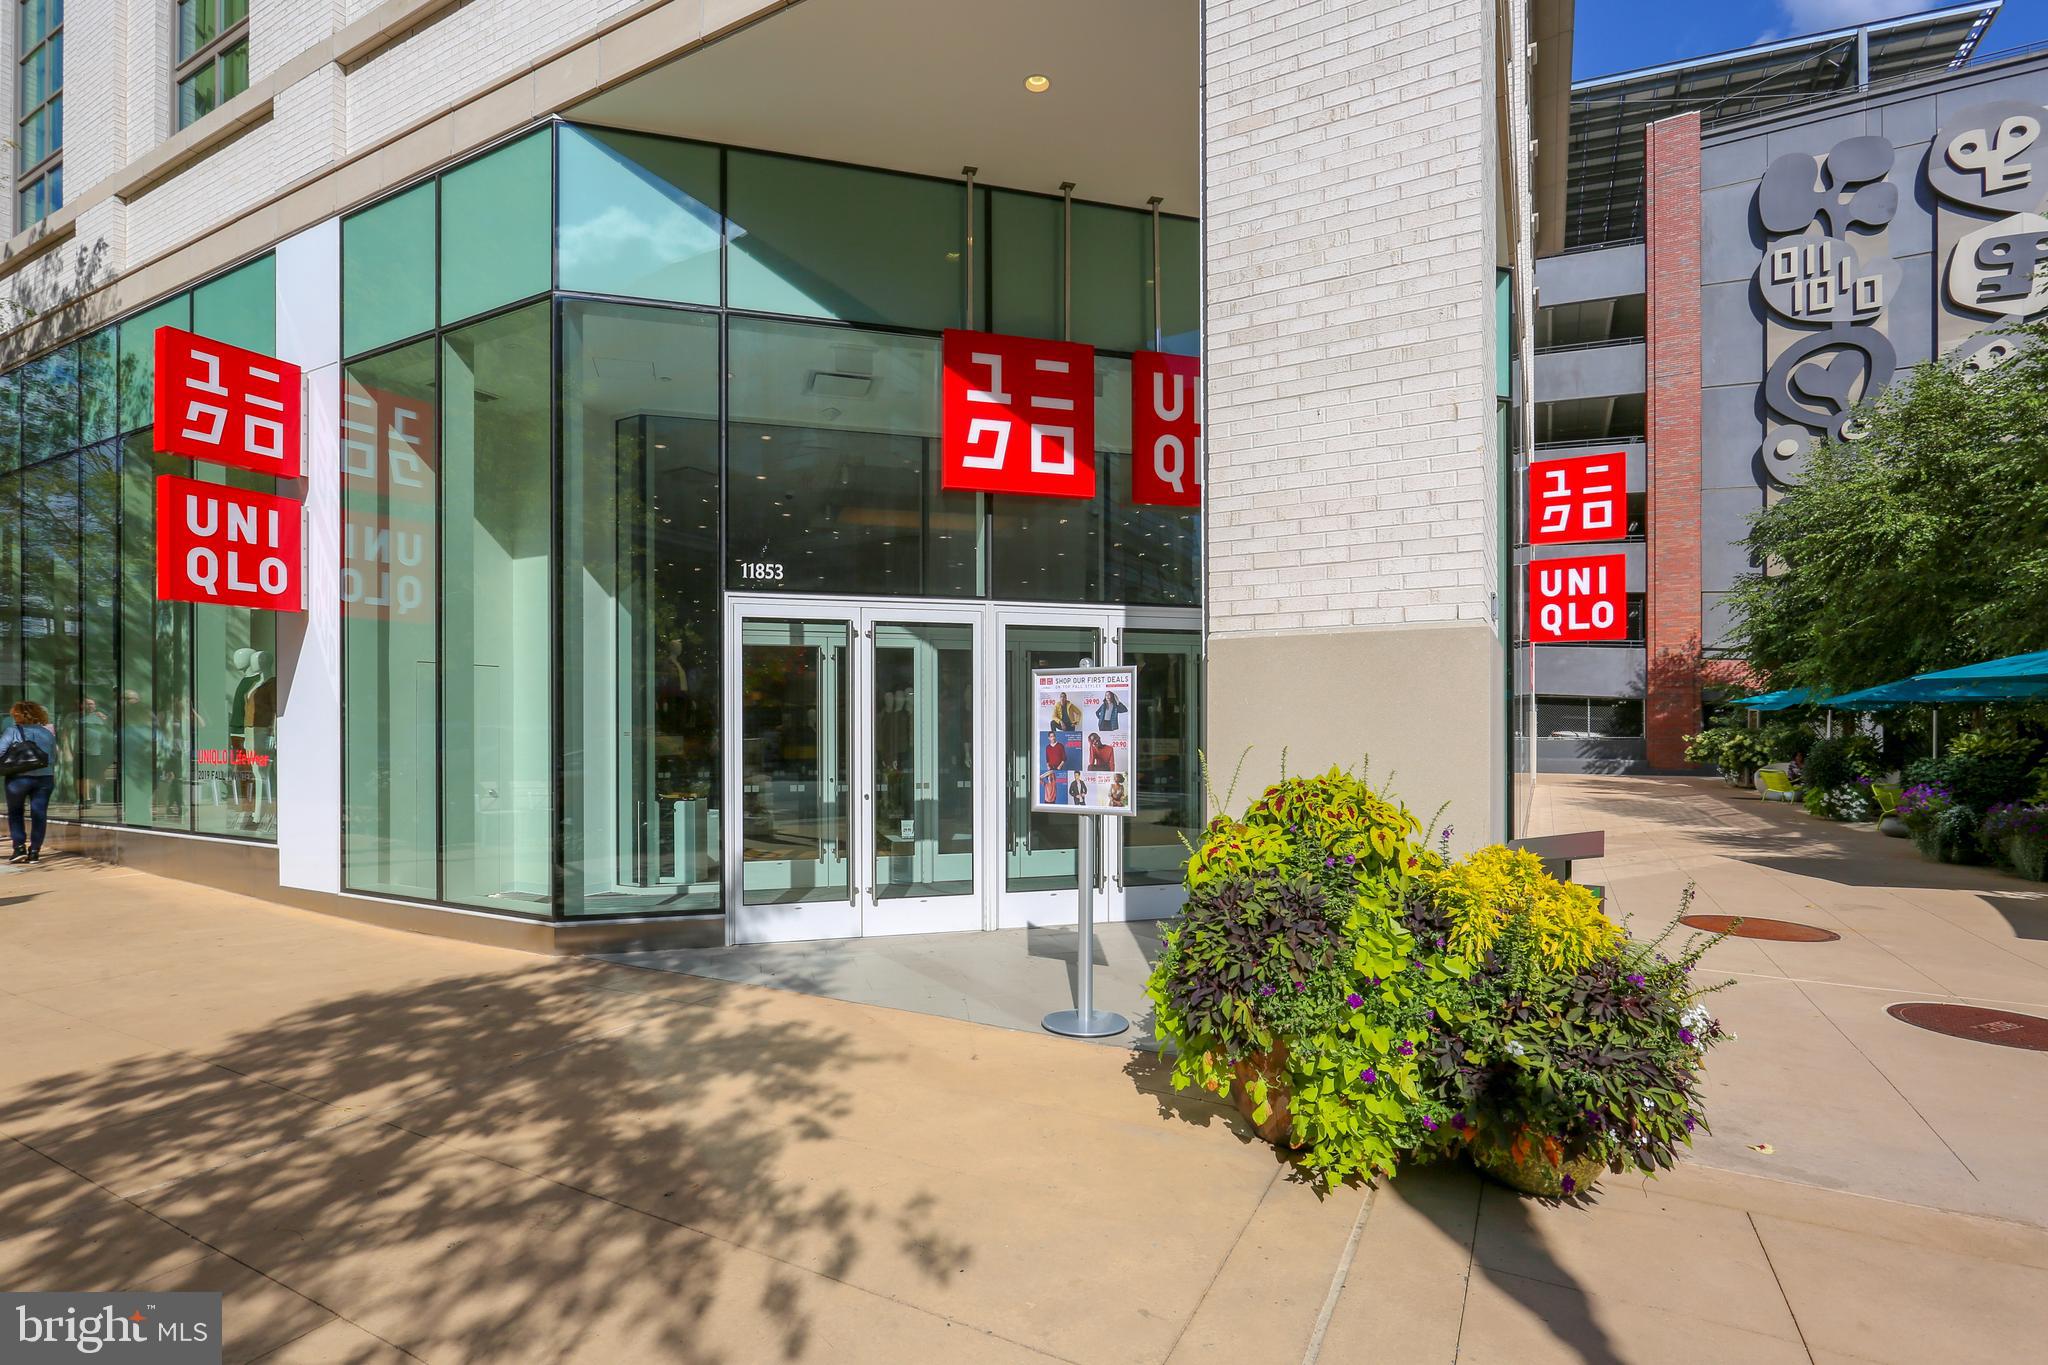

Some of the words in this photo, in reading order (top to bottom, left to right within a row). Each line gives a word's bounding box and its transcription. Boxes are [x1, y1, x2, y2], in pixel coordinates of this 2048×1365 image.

[1153, 371, 1201, 424] U
[1153, 434, 1201, 493] Q
[186, 494, 279, 548] UNI
[186, 546, 288, 596] QLO
[741, 563, 784, 580] 11853
[1540, 566, 1607, 598] UNI
[1540, 600, 1615, 636] QLO
[197, 749, 228, 765] UNIQLO
